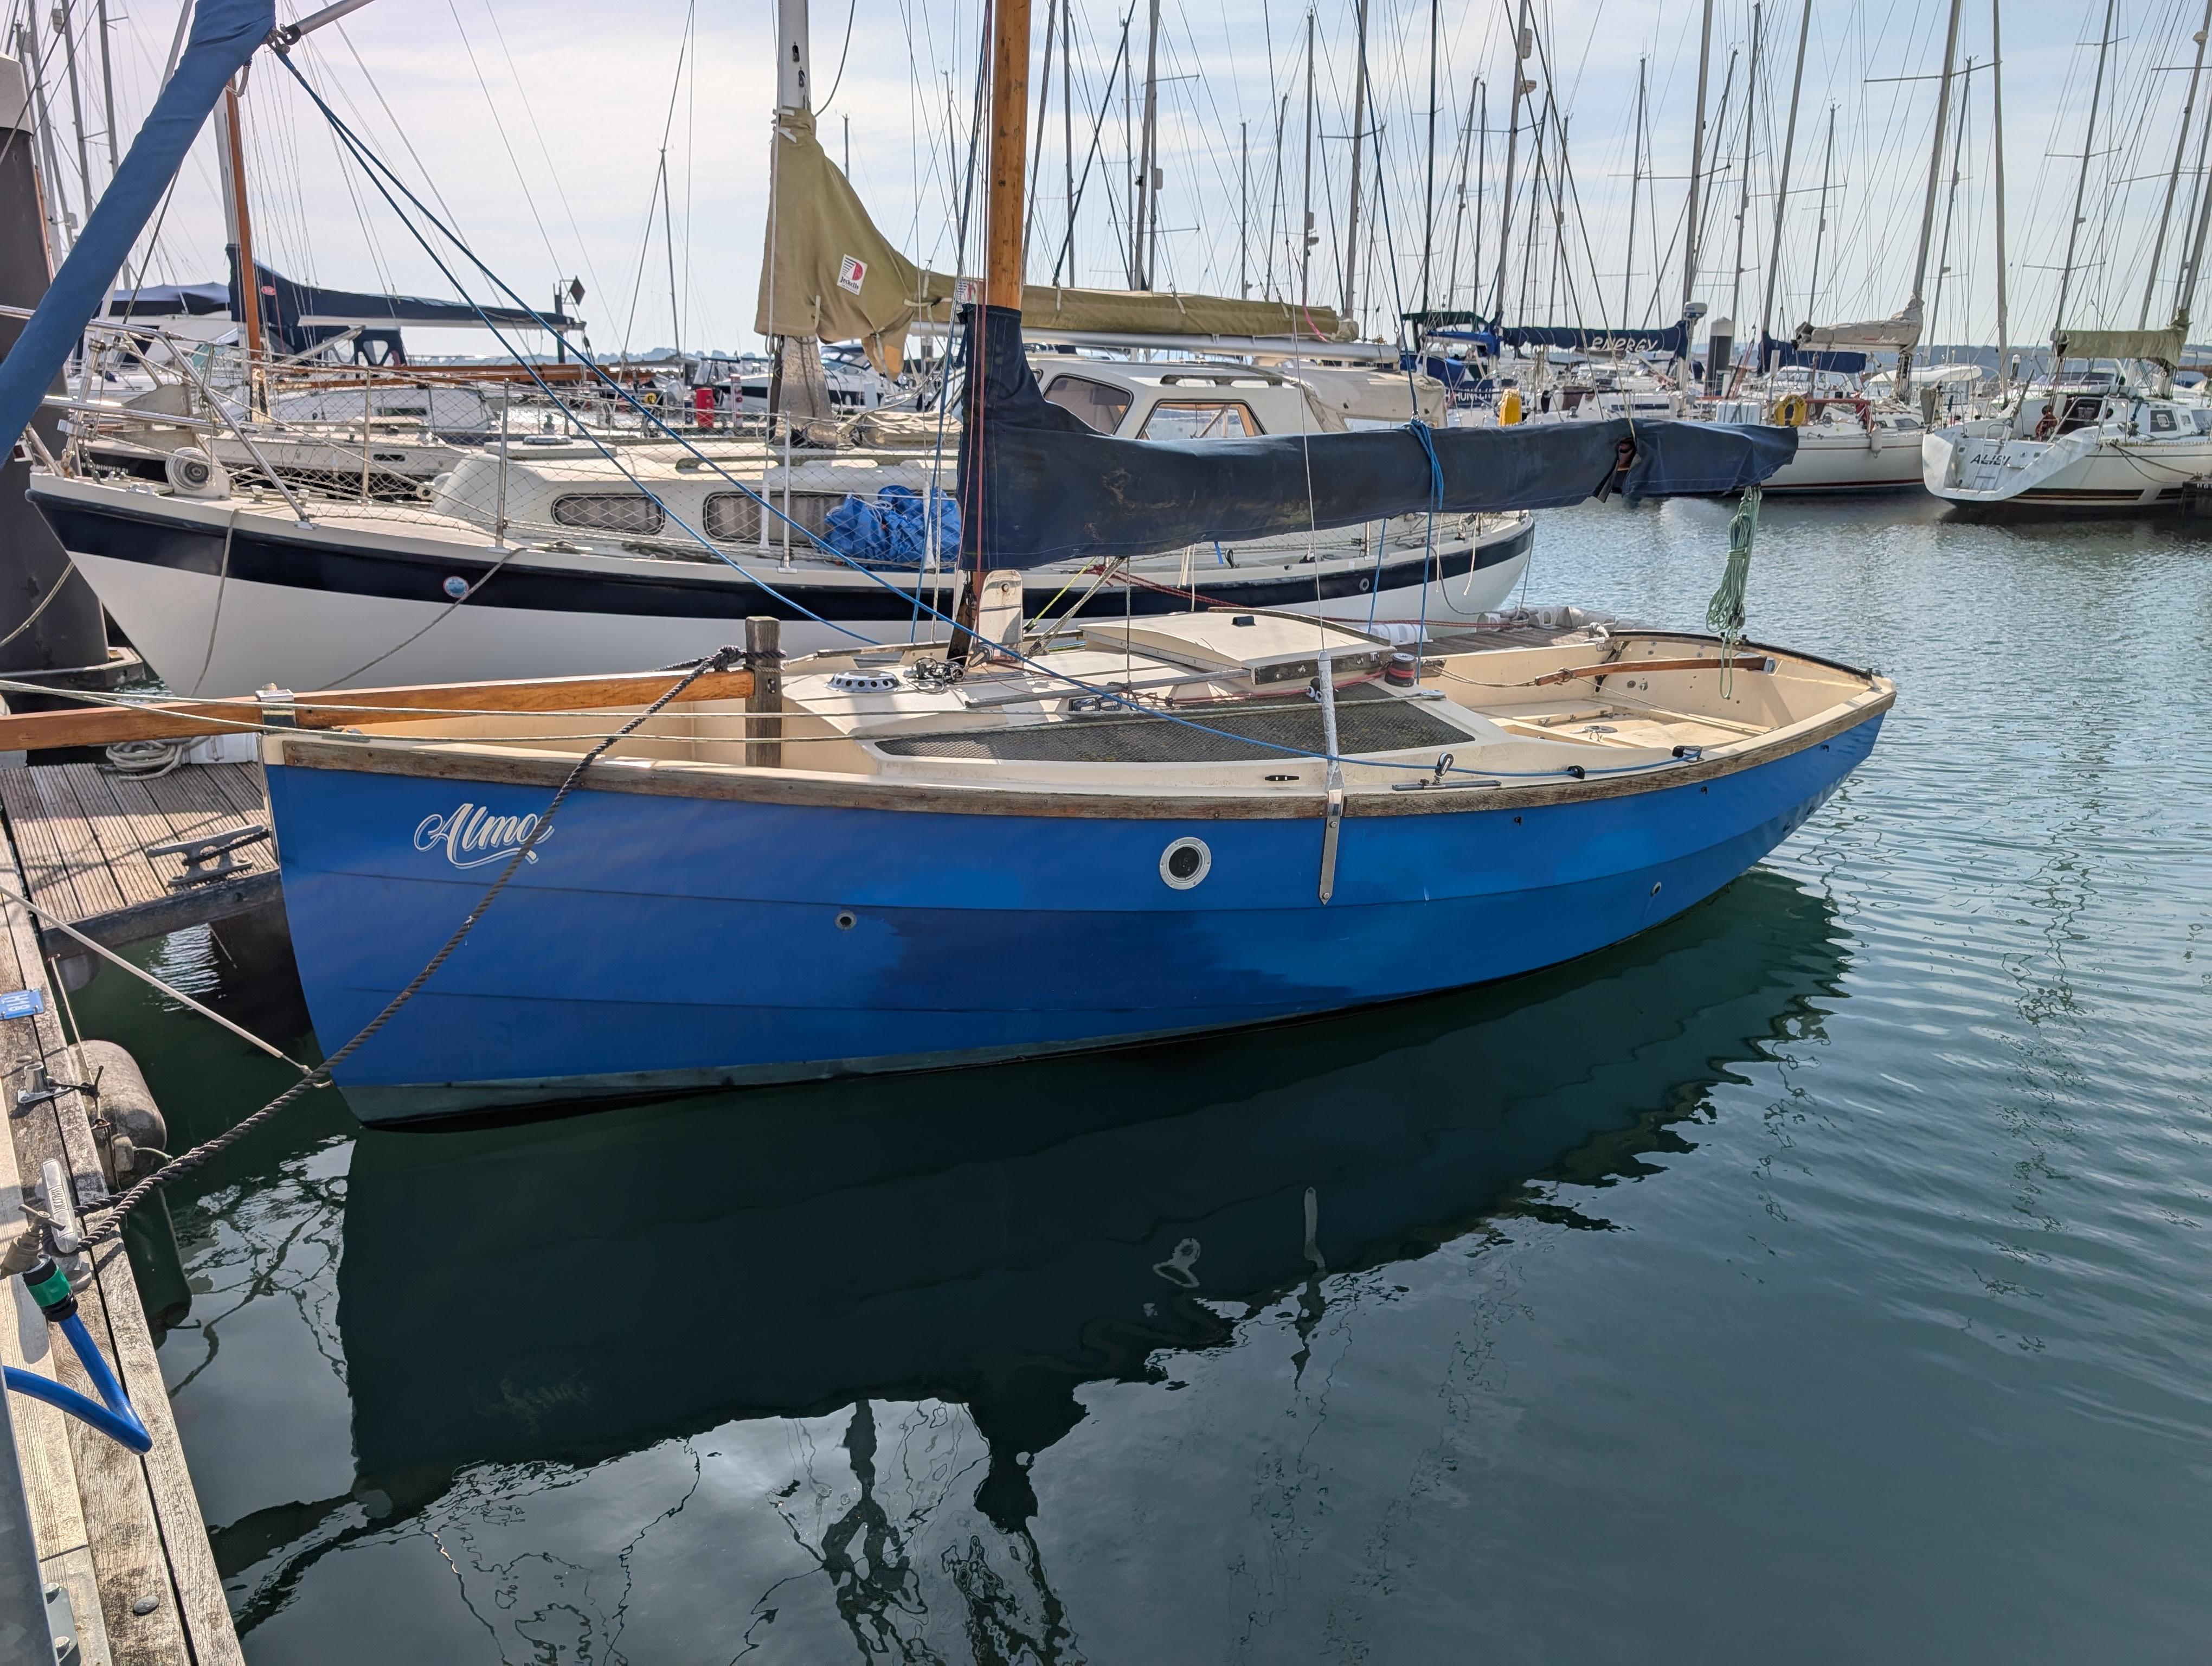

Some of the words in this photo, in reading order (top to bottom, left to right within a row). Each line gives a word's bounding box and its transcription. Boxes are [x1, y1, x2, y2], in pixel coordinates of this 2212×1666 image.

[1970, 454, 2011, 465] ALIBI
[4, 994, 30, 1012] H18
[51, 1187, 66, 1212] WALCON
